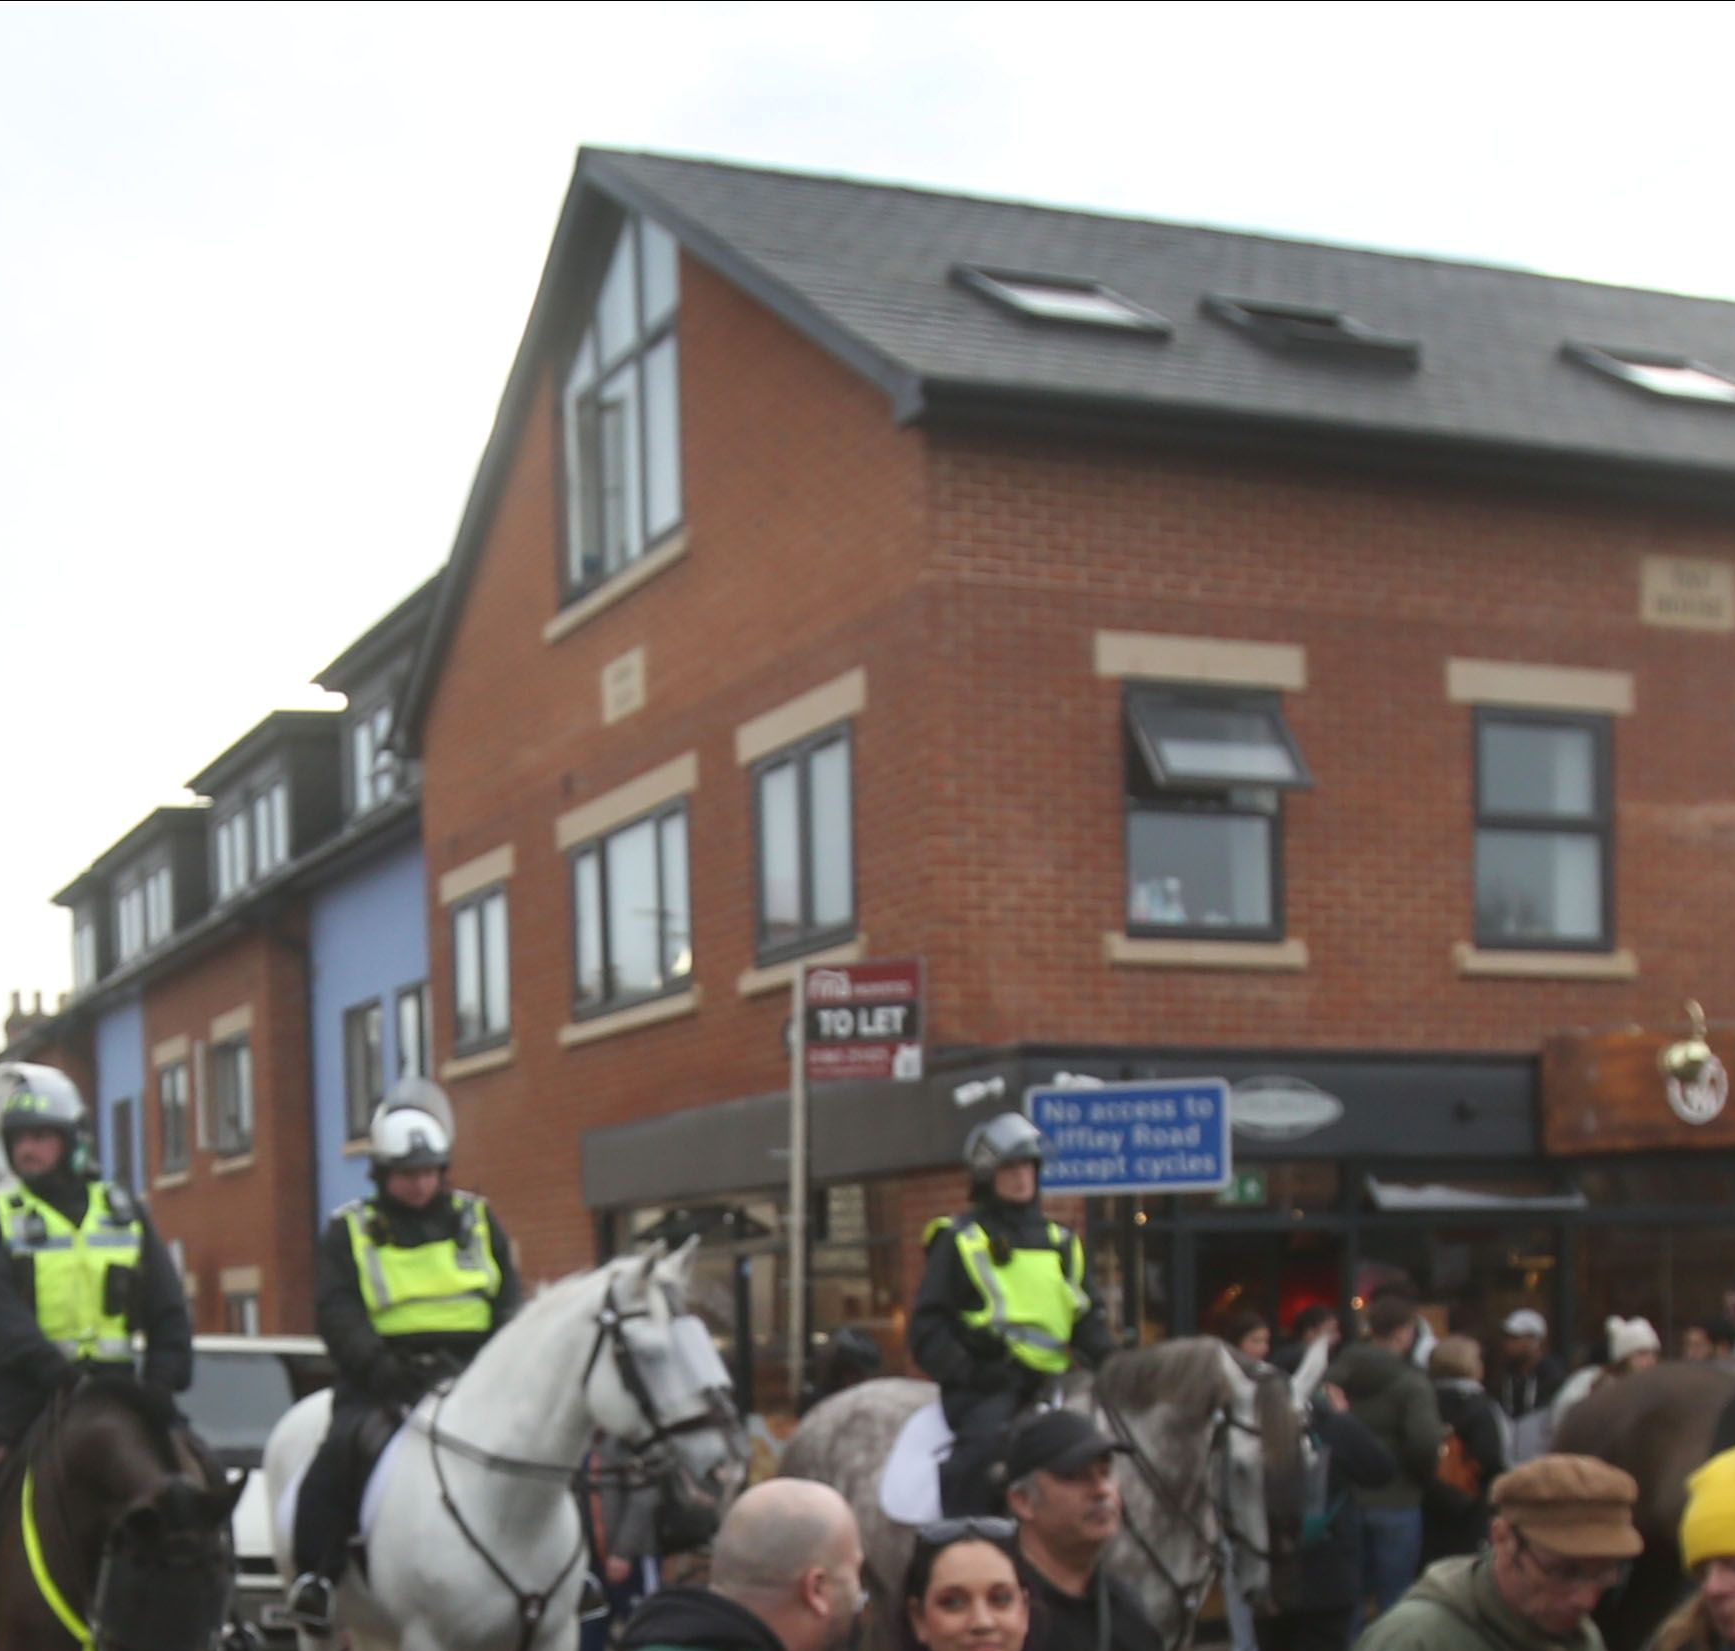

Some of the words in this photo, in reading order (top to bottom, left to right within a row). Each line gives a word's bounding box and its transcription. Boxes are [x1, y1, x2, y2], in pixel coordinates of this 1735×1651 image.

[817, 1007, 854, 1038] TO
[857, 1005, 907, 1037] LET
[1041, 1099, 1082, 1122] No
[1089, 1100, 1177, 1122] access
[1183, 1094, 1214, 1117] to
[1131, 1123, 1201, 1147] Road
[1042, 1154, 1126, 1180] except
[1135, 1150, 1216, 1178] cycles
